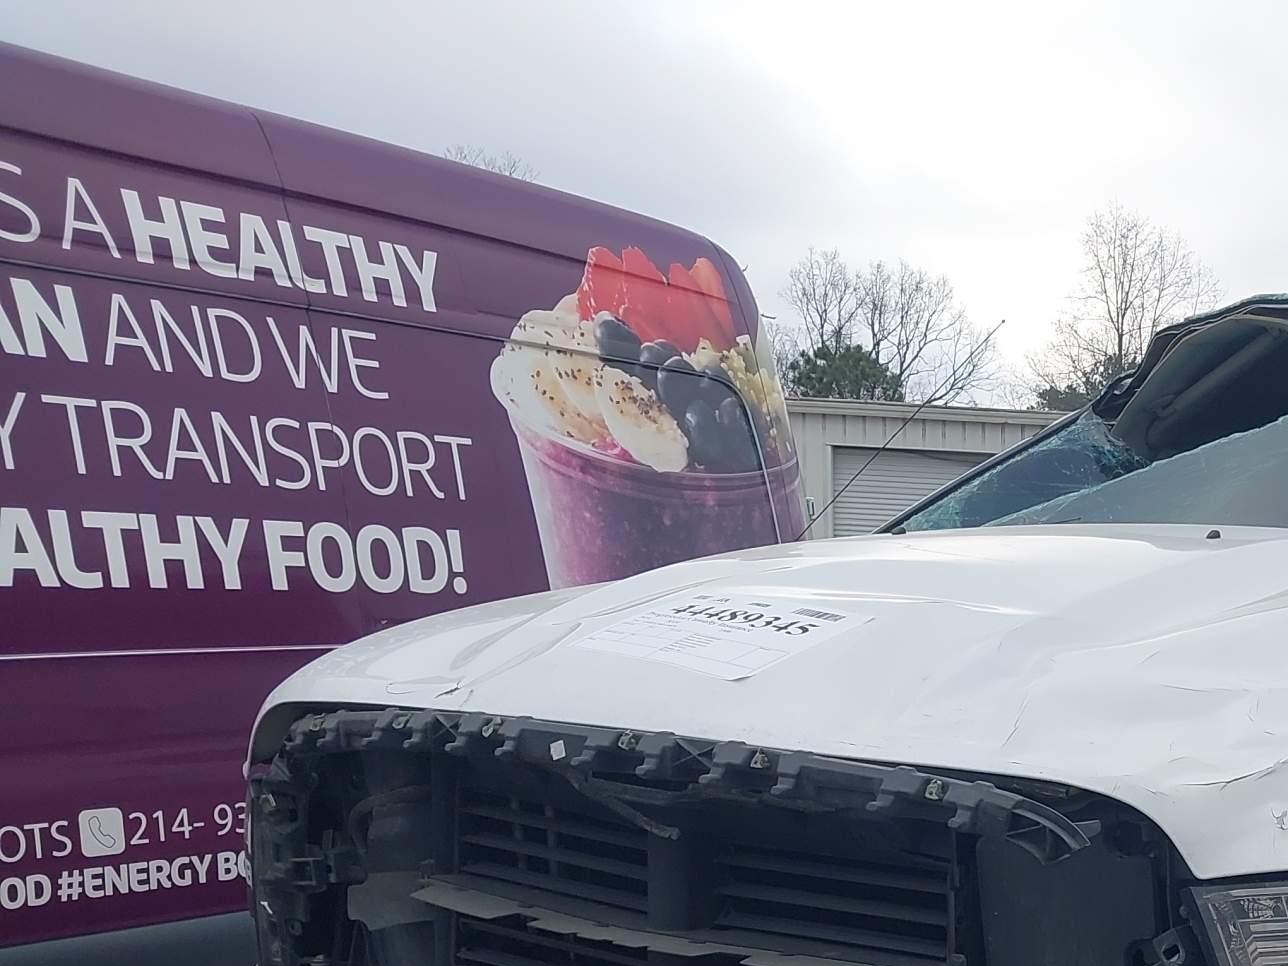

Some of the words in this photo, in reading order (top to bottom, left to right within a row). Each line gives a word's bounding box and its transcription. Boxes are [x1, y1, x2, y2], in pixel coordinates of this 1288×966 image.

[61, 176, 122, 259] A
[120, 187, 438, 313] HEALTHY
[104, 293, 262, 383] AND
[266, 316, 390, 400] WE
[41, 394, 472, 501] TRANSPORT
[0, 507, 250, 590] ALTHY
[262, 519, 468, 594] FOOD!
[672, 604, 821, 636] 44489345
[0, 820, 73, 863] OTS
[0, 874, 52, 910] OD
[57, 854, 214, 902] #ENERGY
